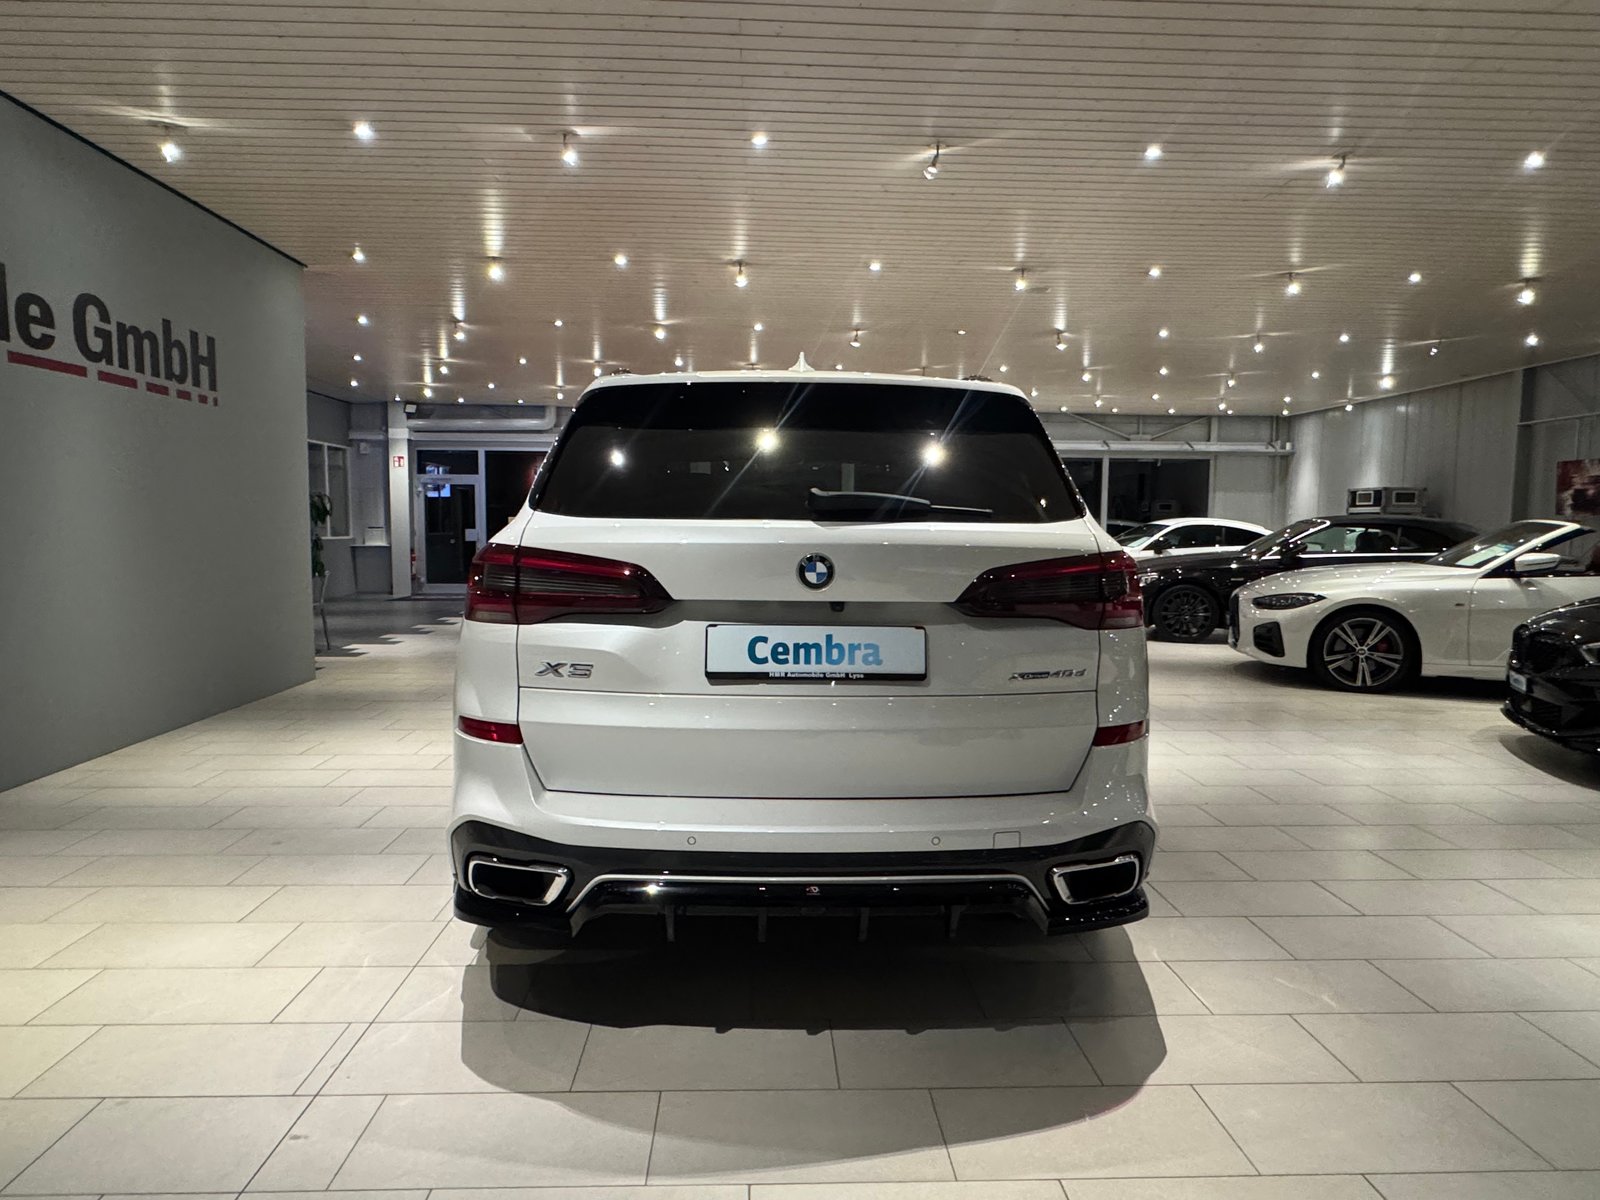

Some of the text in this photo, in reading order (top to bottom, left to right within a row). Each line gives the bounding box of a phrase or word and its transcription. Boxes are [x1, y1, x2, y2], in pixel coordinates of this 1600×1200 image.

[72, 293, 218, 392] GmbH
[747, 634, 883, 665] Cembra
[534, 661, 594, 679] X5
